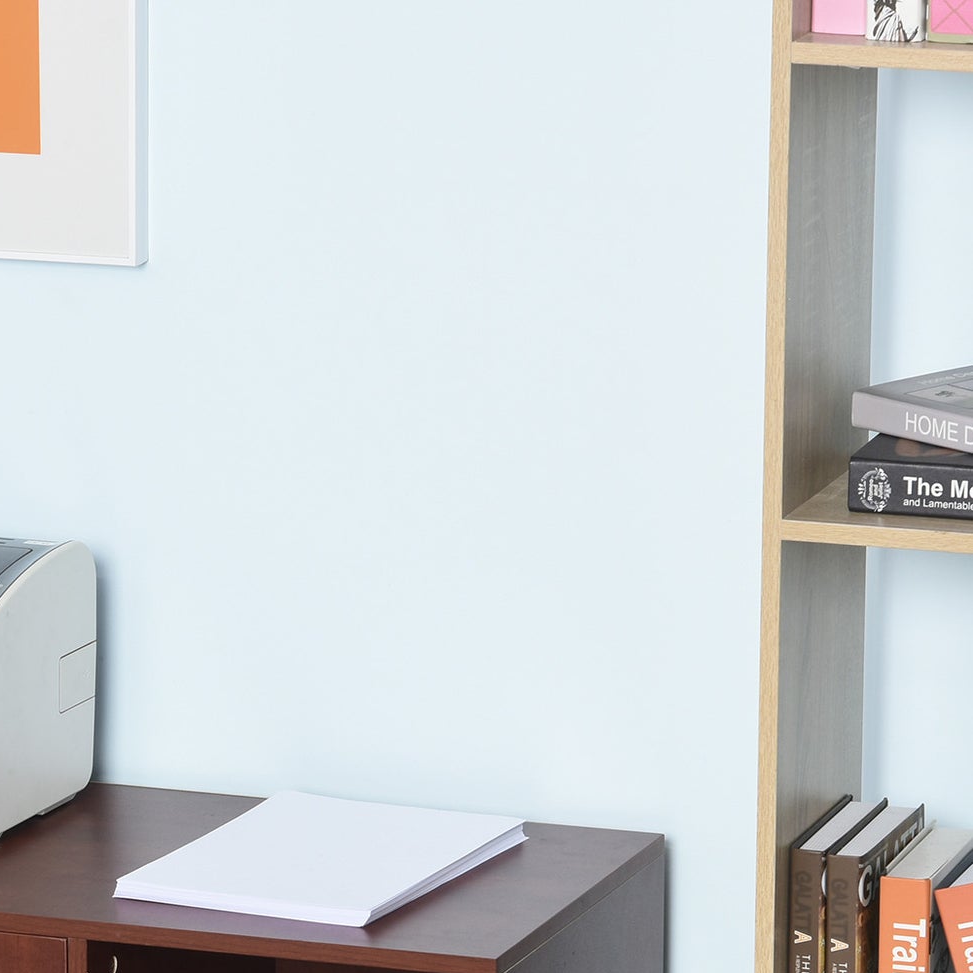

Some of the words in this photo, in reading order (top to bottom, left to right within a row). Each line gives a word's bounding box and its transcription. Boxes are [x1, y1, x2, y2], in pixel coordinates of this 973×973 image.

[904, 411, 959, 442] HOME
[902, 475, 944, 497] The
[950, 479, 973, 500] M
[902, 498, 921, 508] and
